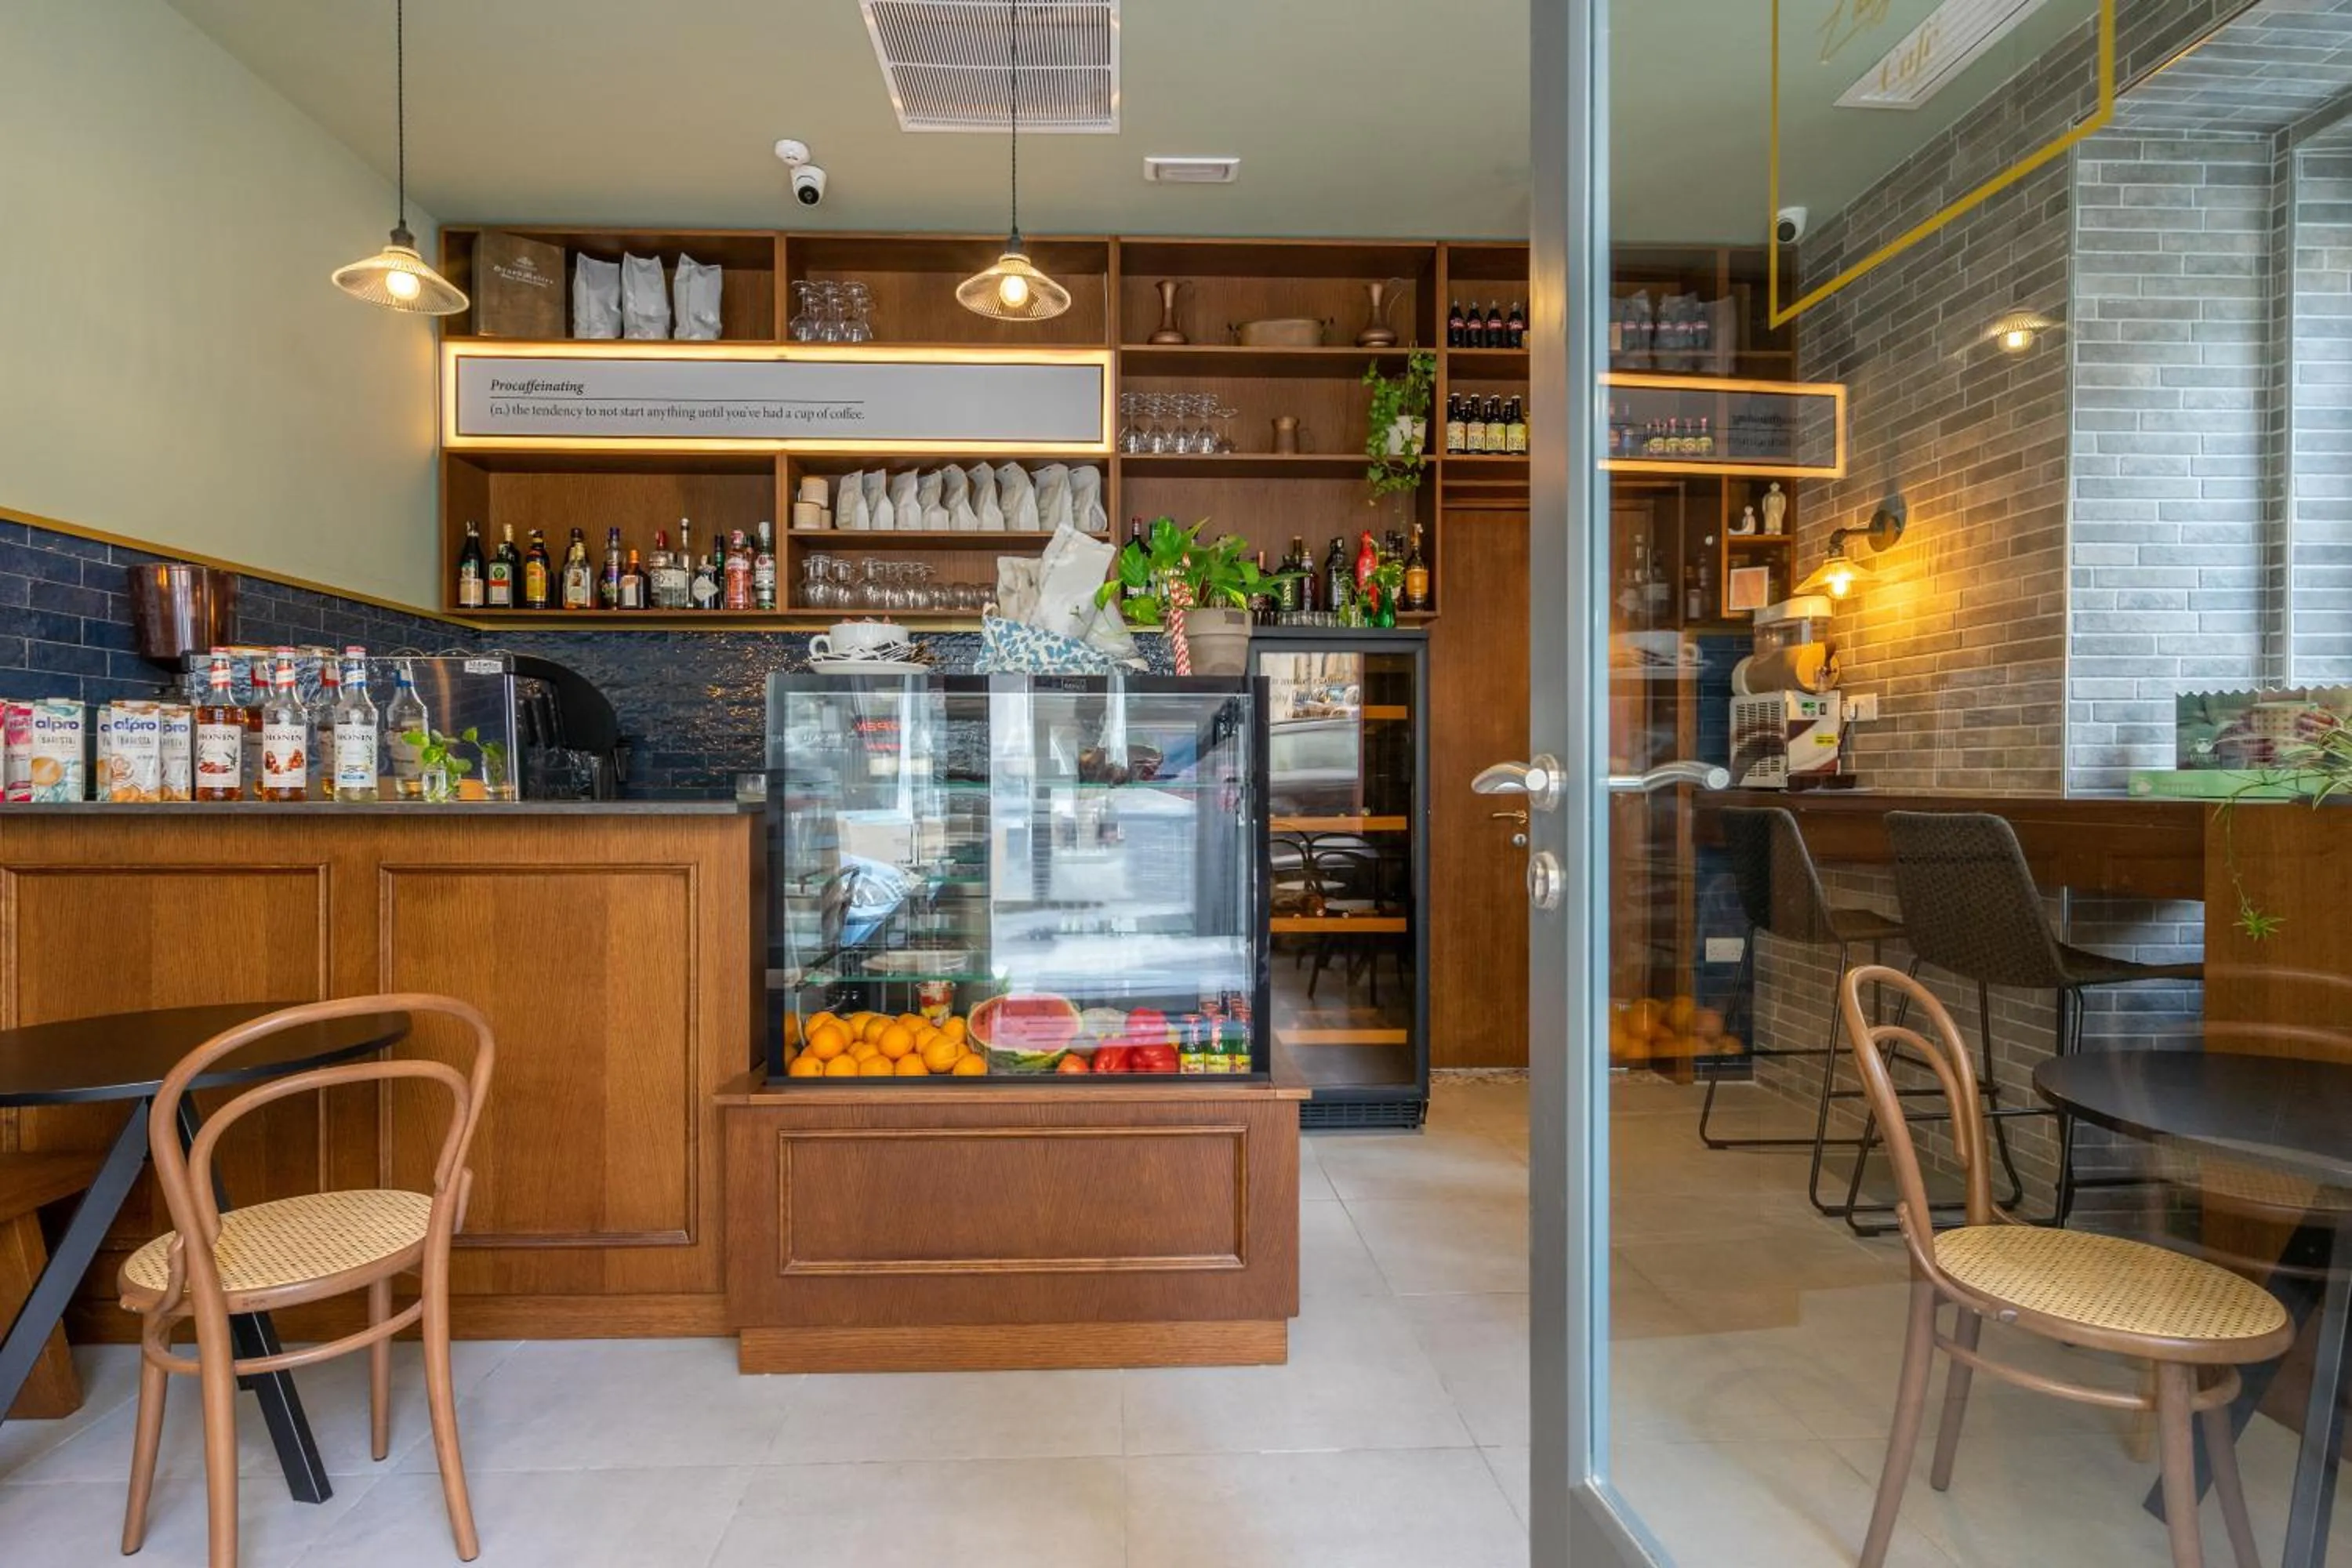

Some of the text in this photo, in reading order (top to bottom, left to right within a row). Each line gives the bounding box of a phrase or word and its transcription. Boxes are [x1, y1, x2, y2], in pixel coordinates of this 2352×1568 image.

[490, 379, 584, 395] Procaffeinating
[490, 403, 865, 423] (n.) the tendency to not start anything until you've had a cup of coffee.
[35, 717, 79, 732] alpro
[114, 717, 157, 733] alpro
[159, 719, 188, 735] lpro
